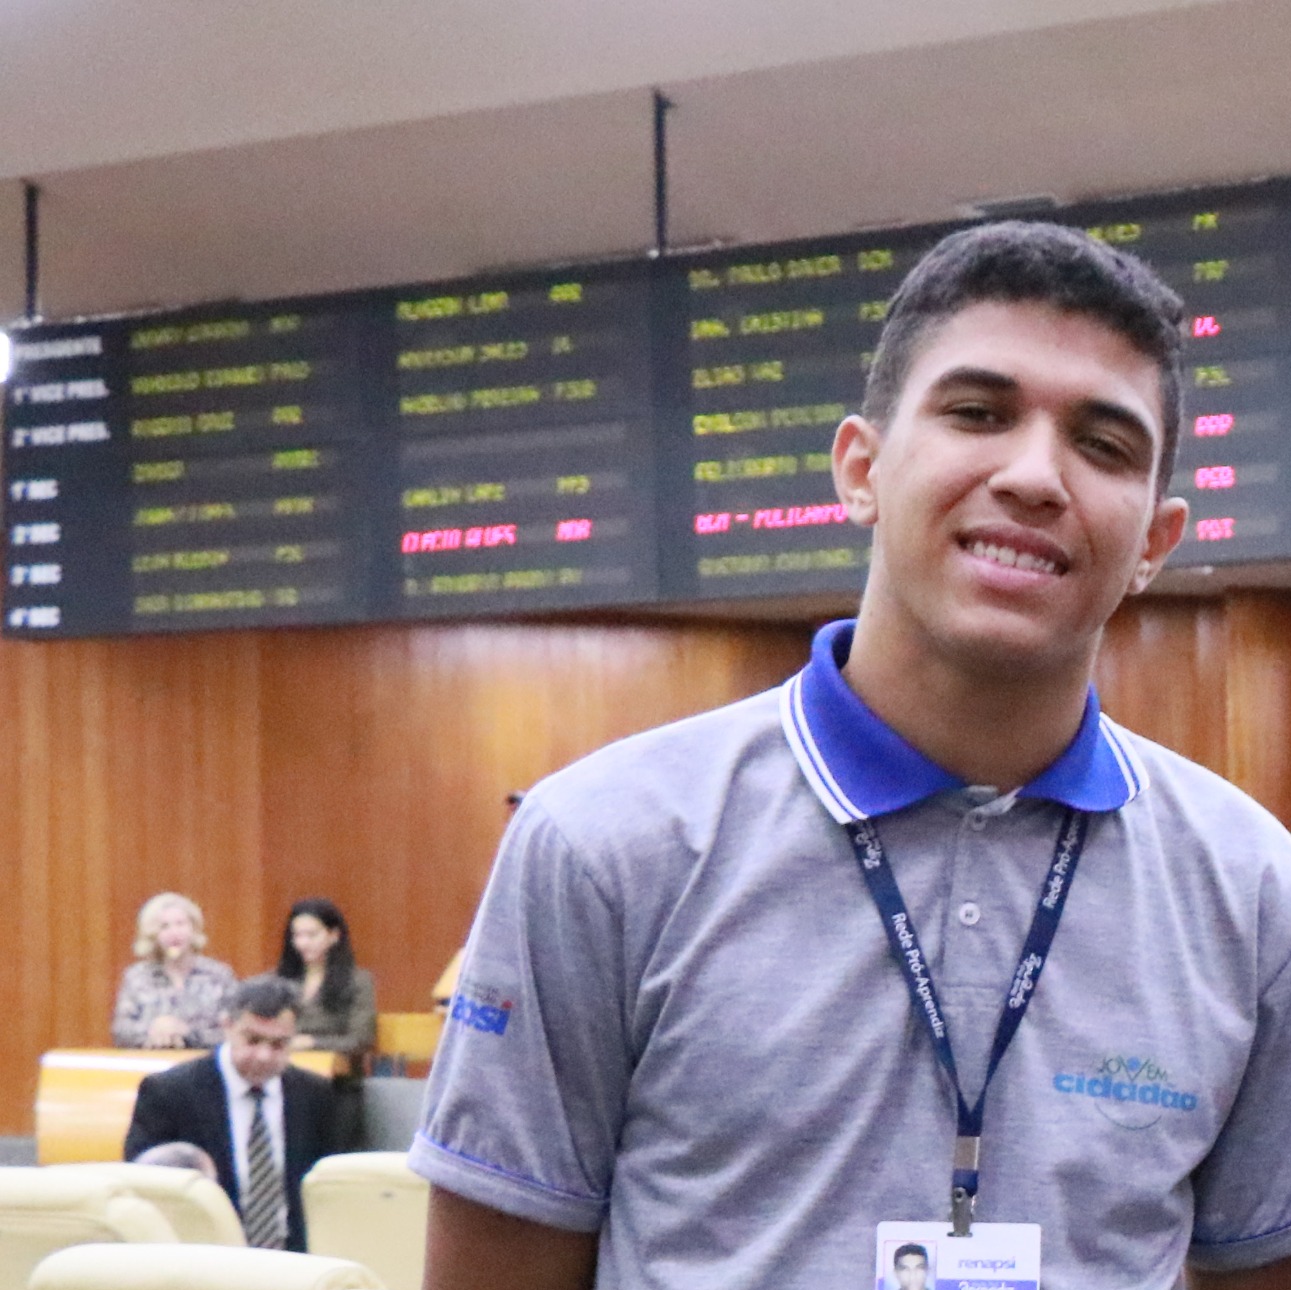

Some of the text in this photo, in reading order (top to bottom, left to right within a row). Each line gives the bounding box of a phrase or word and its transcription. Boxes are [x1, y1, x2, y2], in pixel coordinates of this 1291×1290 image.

[892, 912, 945, 1039] Rede Pró-Aprendiz
[958, 1256, 1016, 1274] renapsi
